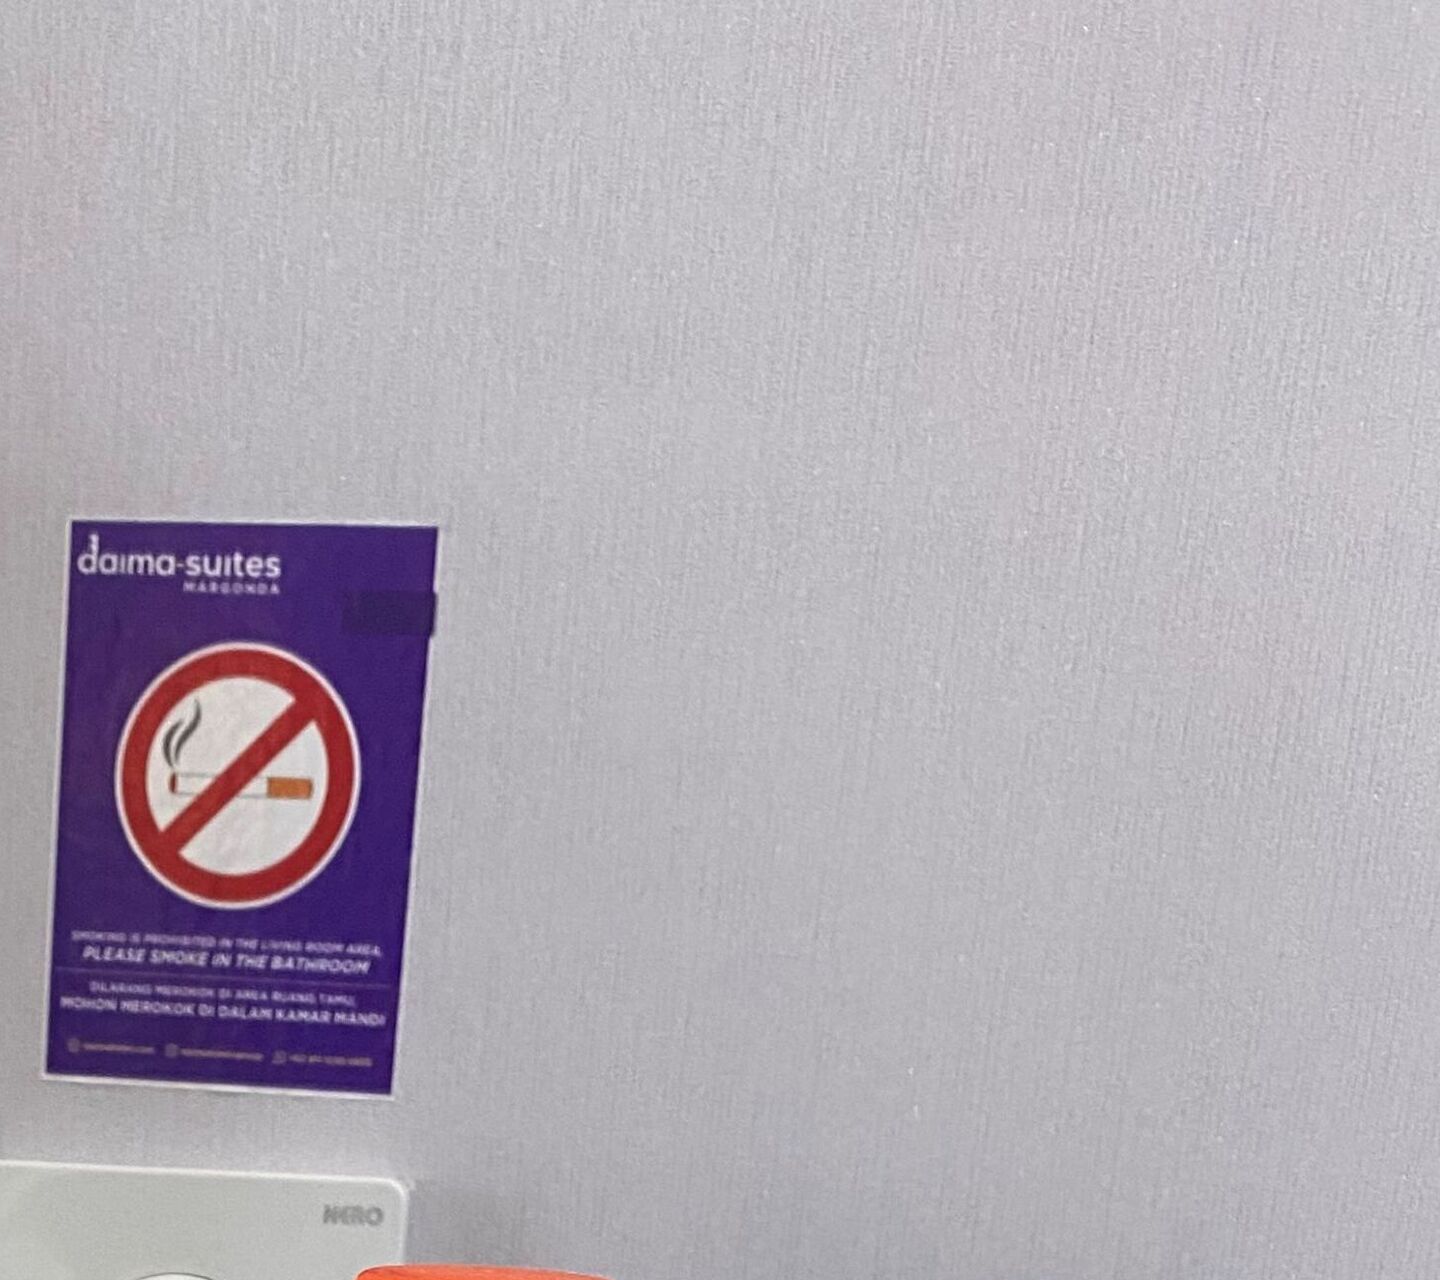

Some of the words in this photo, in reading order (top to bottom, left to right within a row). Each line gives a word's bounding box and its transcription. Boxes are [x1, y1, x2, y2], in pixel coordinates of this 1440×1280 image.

[182, 580, 281, 595] MARGONDA
[82, 945, 146, 962] PLEASE
[149, 949, 209, 967] SMOKE
[211, 952, 233, 968] IN
[235, 953, 269, 970] THE
[270, 955, 372, 975] BATHROOM
[89, 980, 153, 995] DILARANG
[60, 996, 118, 1011] MOHON
[119, 999, 196, 1015] MEROKOK
[197, 1002, 215, 1017] DI
[217, 1004, 273, 1020] DALAM
[275, 1008, 331, 1024] KAMAR
[333, 1011, 387, 1027] MANDI
[323, 1203, 384, 1226] NERO
